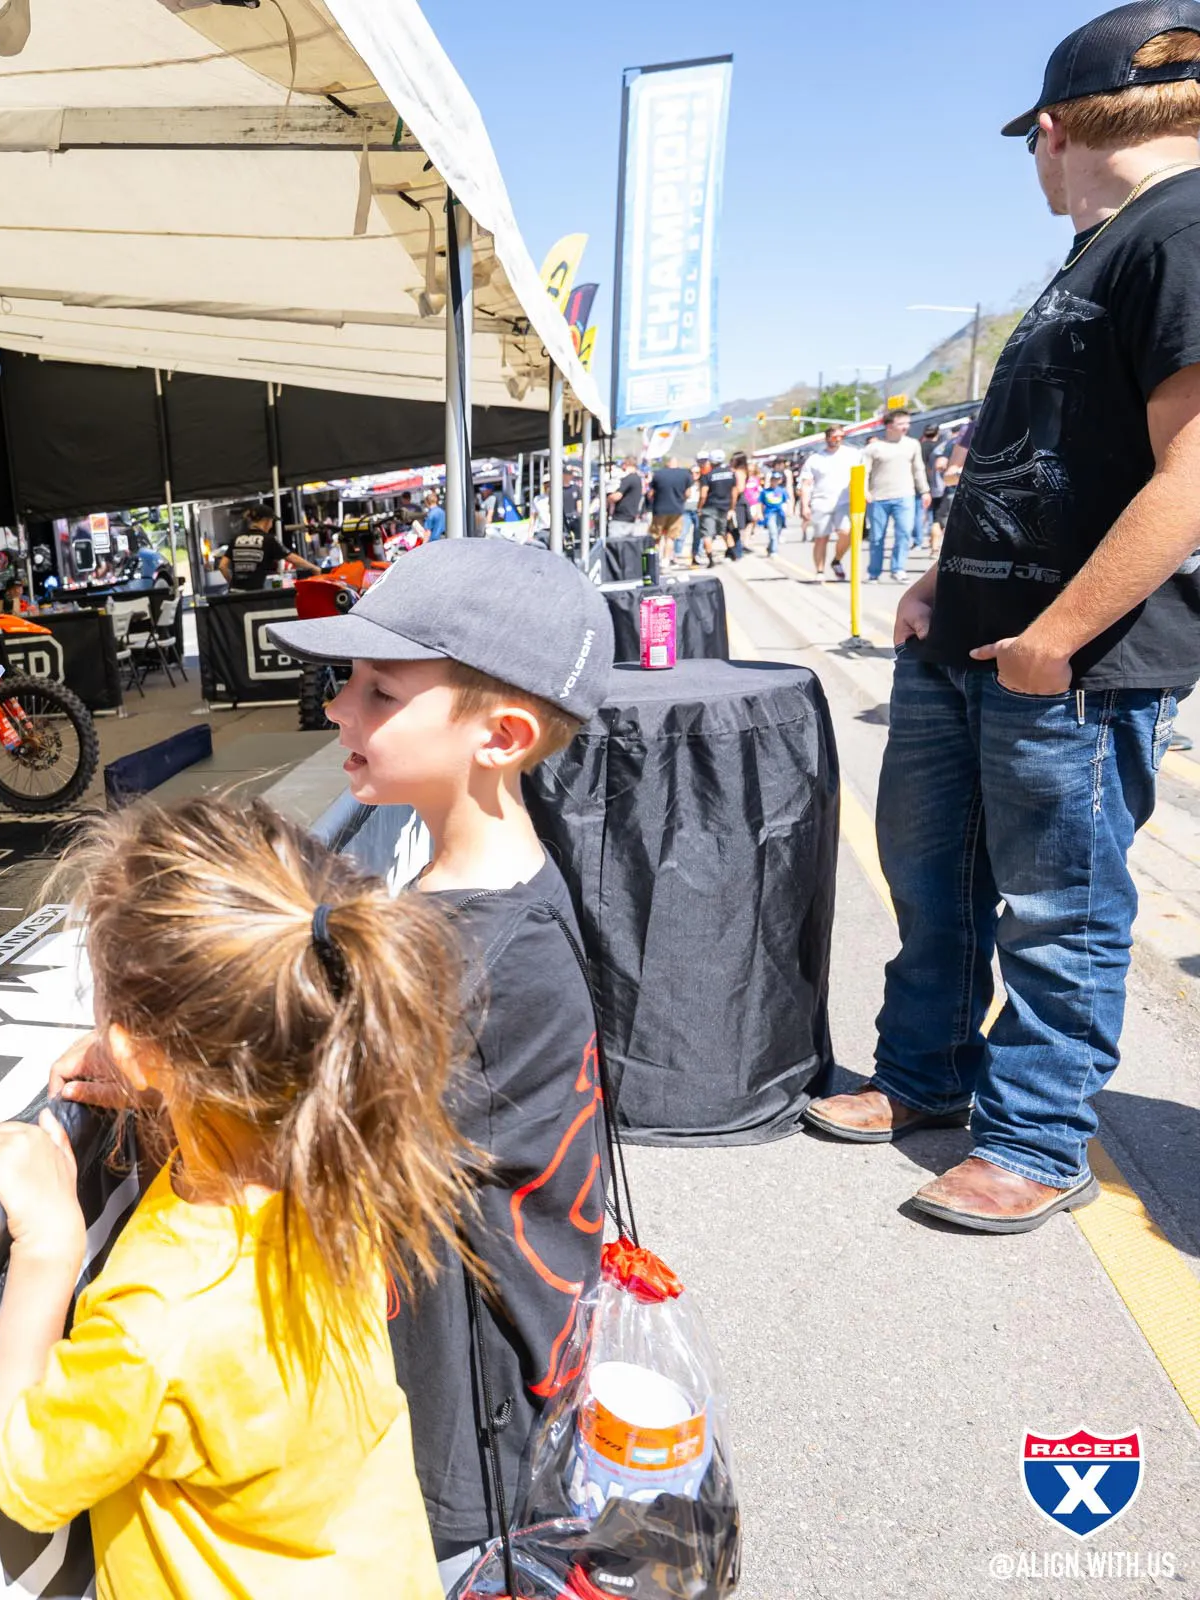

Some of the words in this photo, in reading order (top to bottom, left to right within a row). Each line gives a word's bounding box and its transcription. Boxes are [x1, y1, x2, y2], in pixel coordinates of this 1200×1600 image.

[647, 97, 689, 352] CHAMPION
[681, 267, 698, 349] TOOL
[962, 563, 1007, 574] HONDA
[559, 629, 595, 699] VOLCOM
